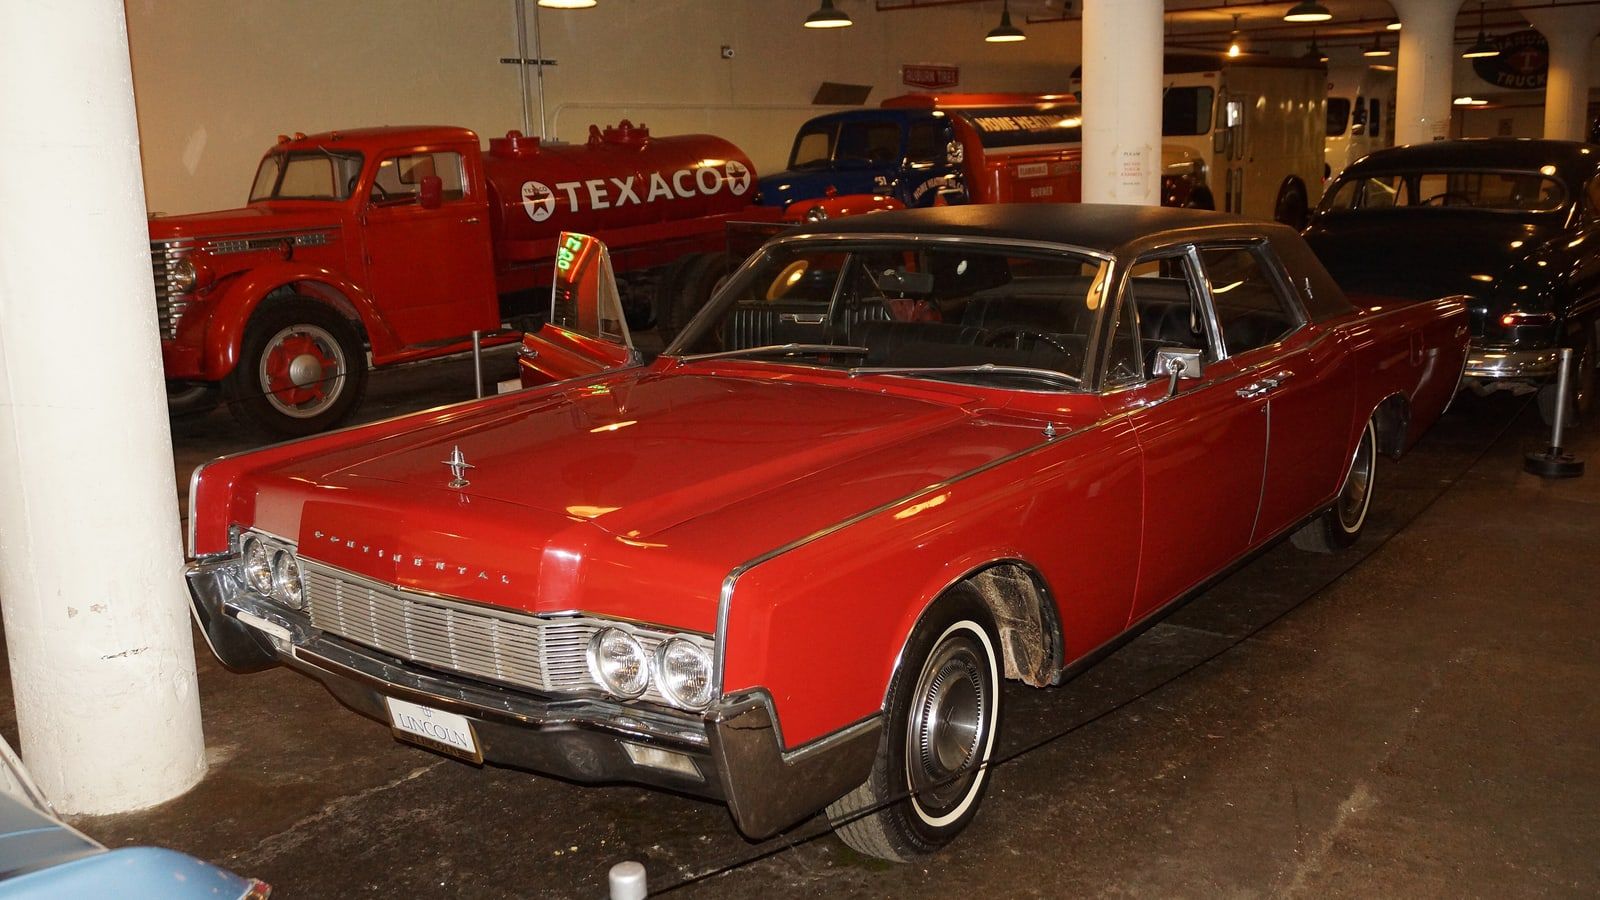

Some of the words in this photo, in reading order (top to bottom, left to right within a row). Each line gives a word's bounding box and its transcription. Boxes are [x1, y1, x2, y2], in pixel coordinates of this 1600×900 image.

[555, 167, 723, 213] TEXACO
[314, 530, 510, 584] CONTINENTAL
[398, 712, 468, 748] LINCOLN
